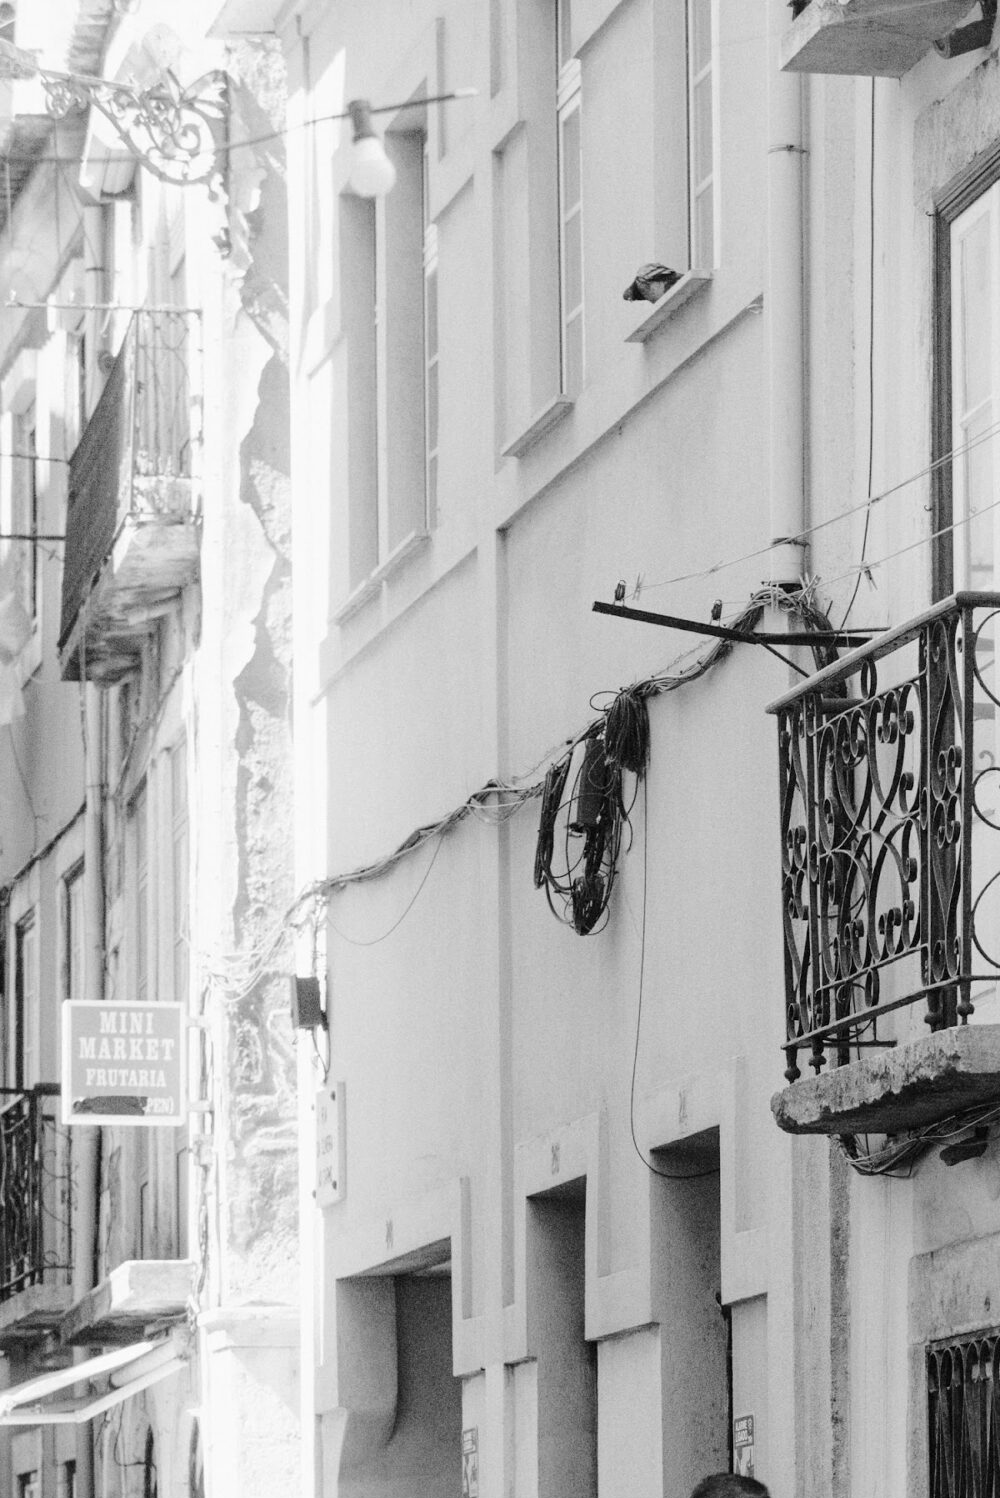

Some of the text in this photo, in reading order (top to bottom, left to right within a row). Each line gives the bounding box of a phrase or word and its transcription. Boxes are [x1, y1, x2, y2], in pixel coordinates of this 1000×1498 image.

[100, 1011, 154, 1034] MINI
[78, 1037, 175, 1060] MARKET
[86, 1068, 167, 1088] FRUTARIA
